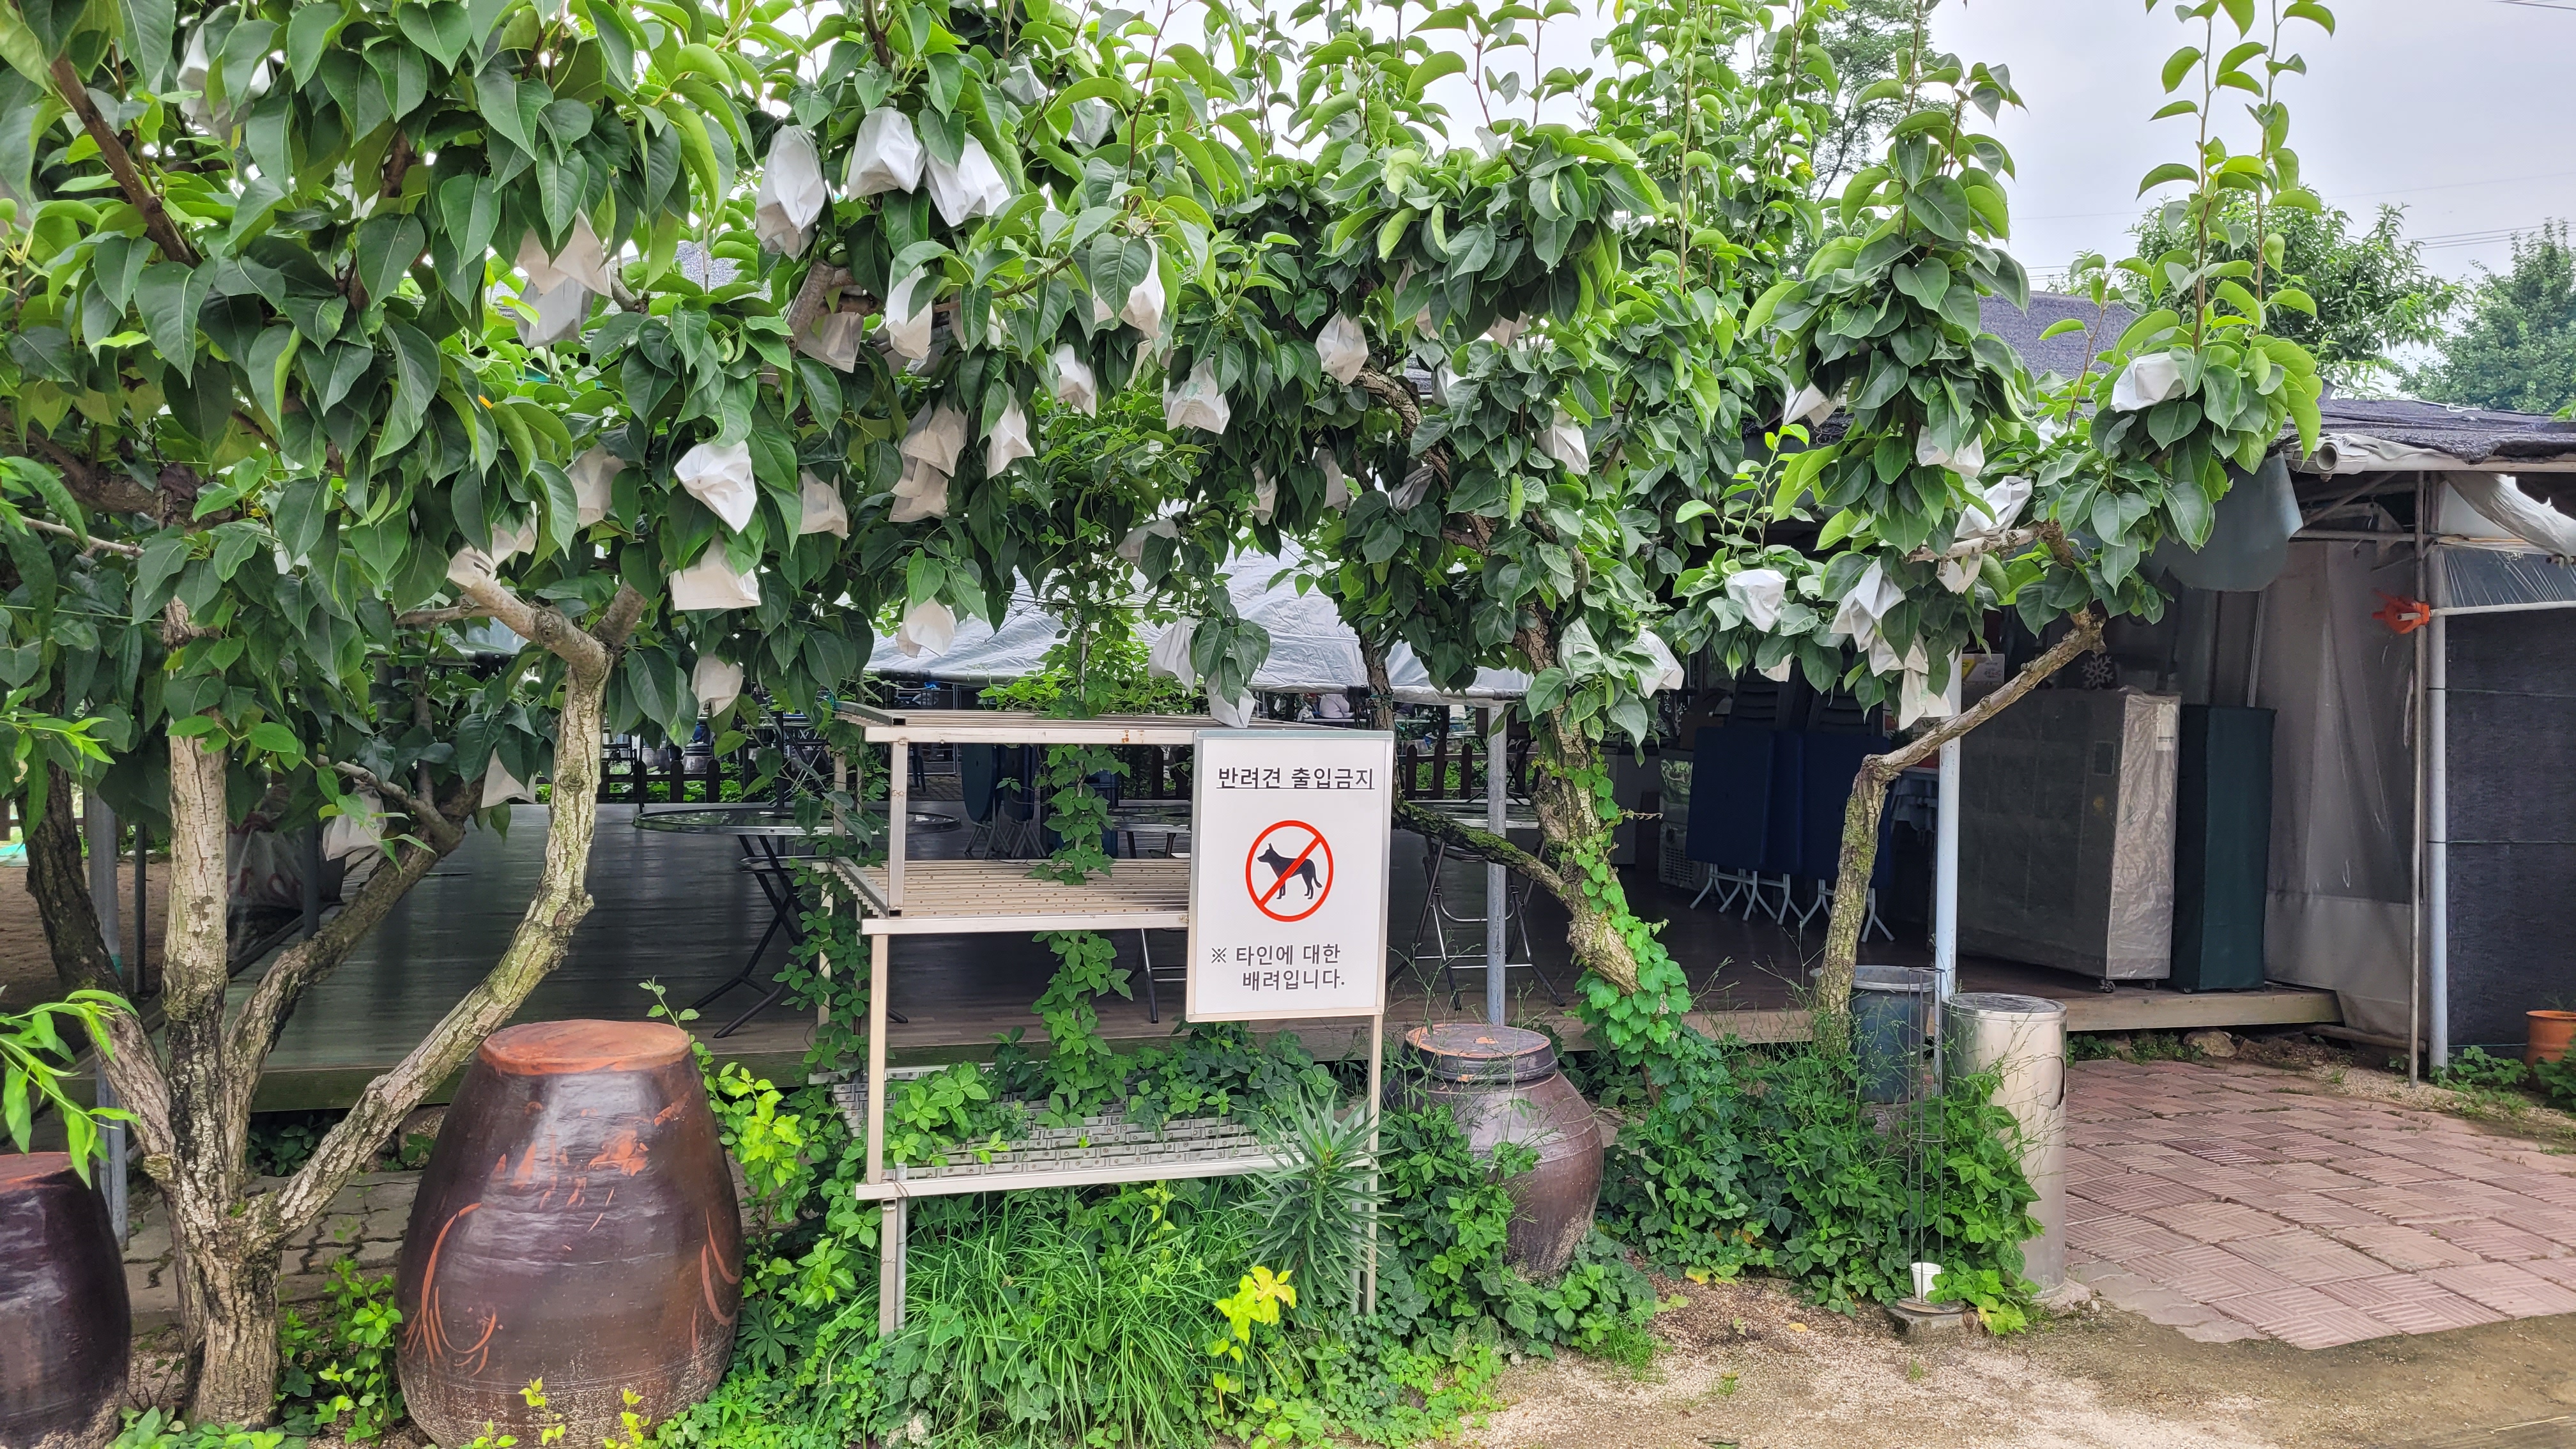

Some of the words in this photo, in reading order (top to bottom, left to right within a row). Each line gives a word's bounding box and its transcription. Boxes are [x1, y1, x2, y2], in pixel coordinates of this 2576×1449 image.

[1218, 767, 1281, 789] 반려견
[1291, 768, 1374, 790] 출입금지
[1236, 944, 1294, 967] 타인에
[1303, 944, 1340, 965] 대한
[1243, 969, 1345, 992] 배려입니다.
